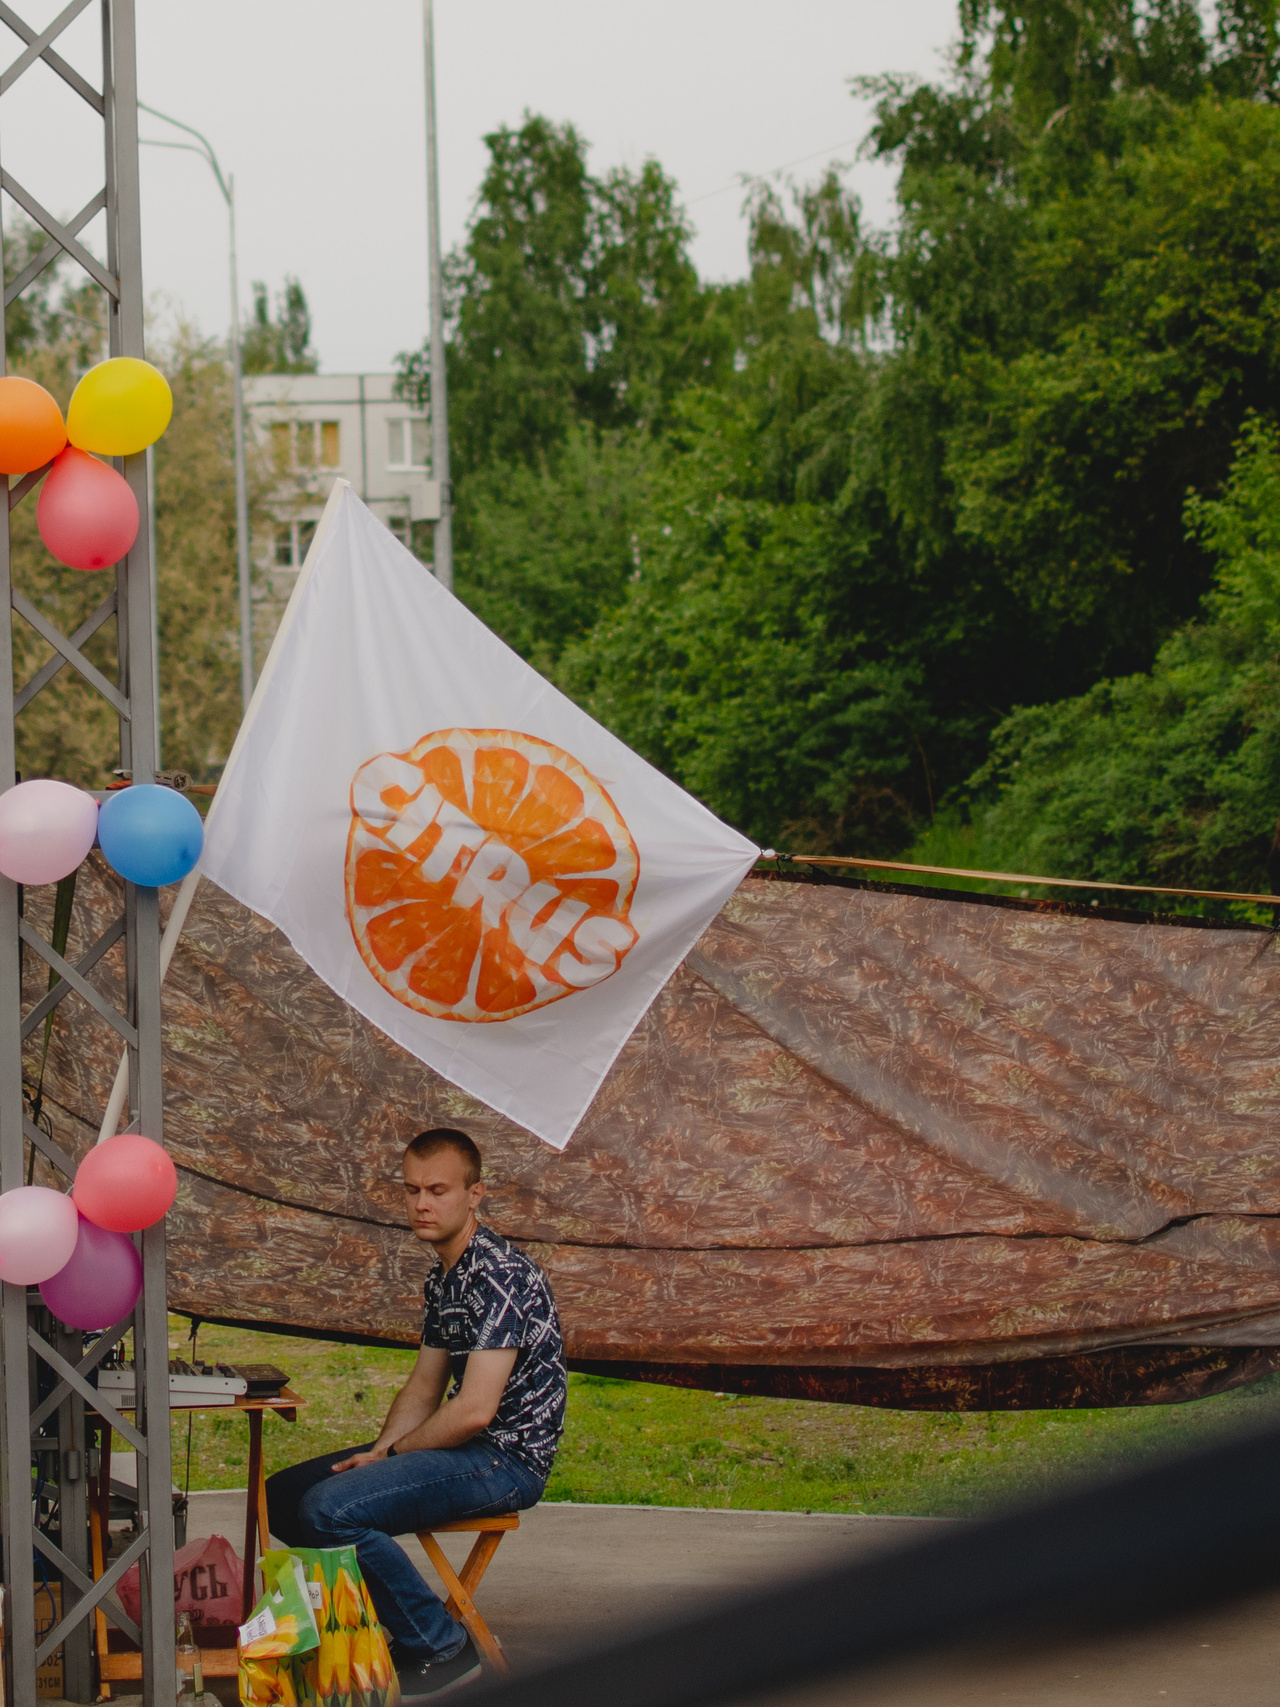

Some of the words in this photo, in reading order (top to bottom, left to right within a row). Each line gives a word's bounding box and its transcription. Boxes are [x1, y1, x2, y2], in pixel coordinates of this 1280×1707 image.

[351, 753, 634, 988] CITRUS
[174, 1564, 229, 1601] УСЬ
[36, 1677, 61, 1689] 31CM
